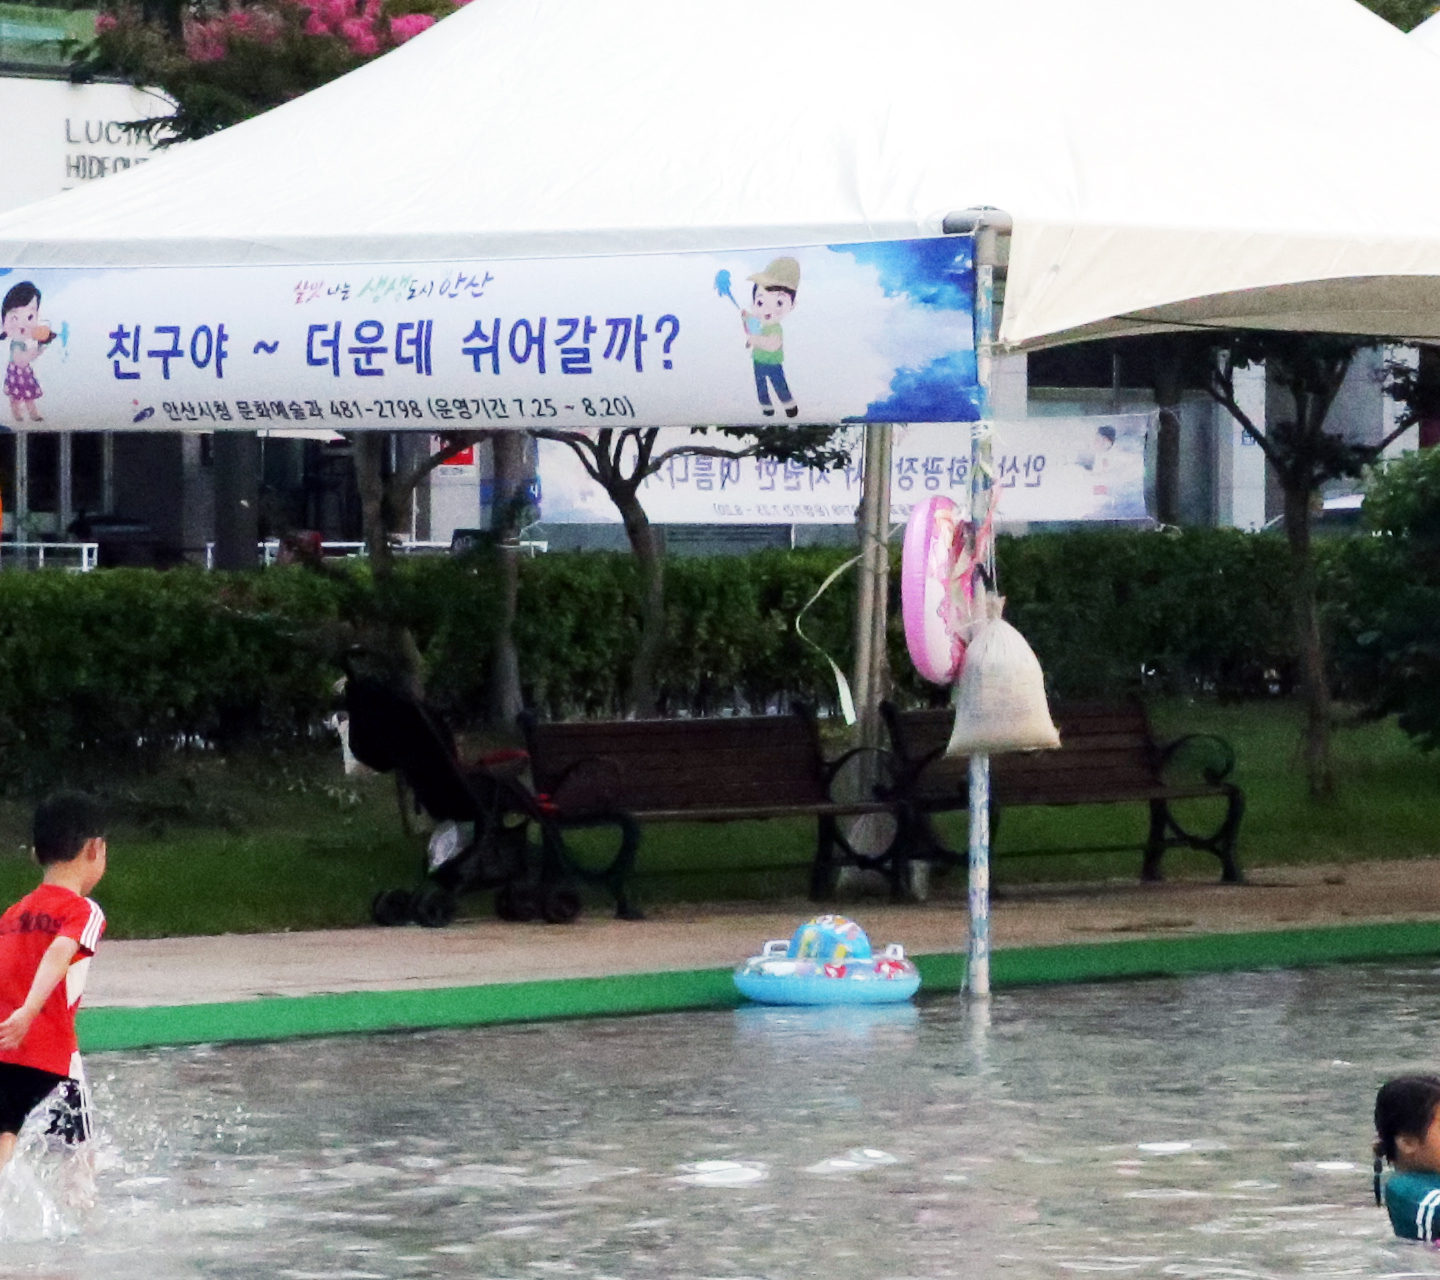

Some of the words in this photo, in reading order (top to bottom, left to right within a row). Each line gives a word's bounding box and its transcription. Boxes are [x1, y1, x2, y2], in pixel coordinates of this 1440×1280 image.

[438, 270, 495, 299] 안산
[106, 322, 229, 381] 친구야
[306, 319, 434, 378] 더운데
[461, 313, 681, 376] 쉬어갈까?
[162, 398, 234, 422] 안산시청
[236, 397, 324, 422] 문화예술과
[329, 397, 423, 421] 481-2798
[427, 396, 510, 420] (운영기간
[512, 396, 558, 418] 7.25
[581, 395, 636, 419] 8.20)
